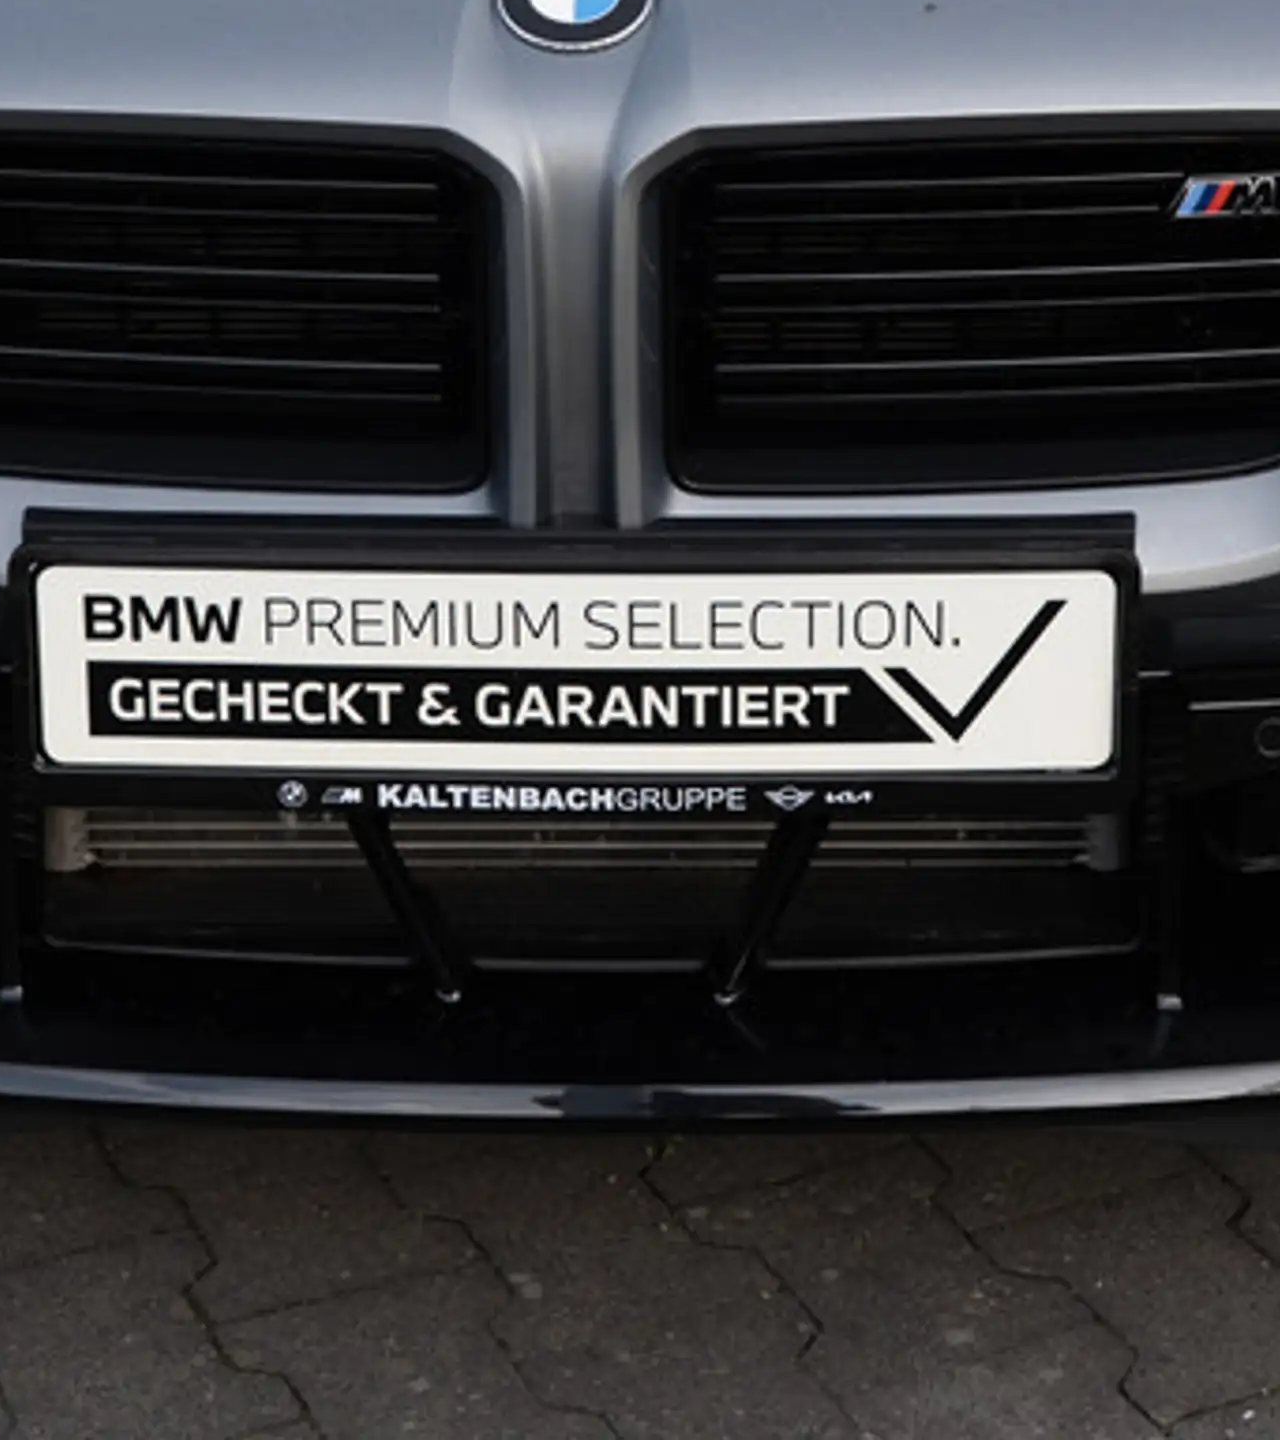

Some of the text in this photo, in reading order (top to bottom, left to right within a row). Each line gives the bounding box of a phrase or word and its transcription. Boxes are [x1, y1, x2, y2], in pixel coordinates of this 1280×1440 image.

[82, 594, 962, 651] BMW PREMIUM SELECTION.
[109, 678, 851, 728] GECHECKT & GARANTIERT
[377, 782, 747, 812] KALTENBACHGRUPPE
